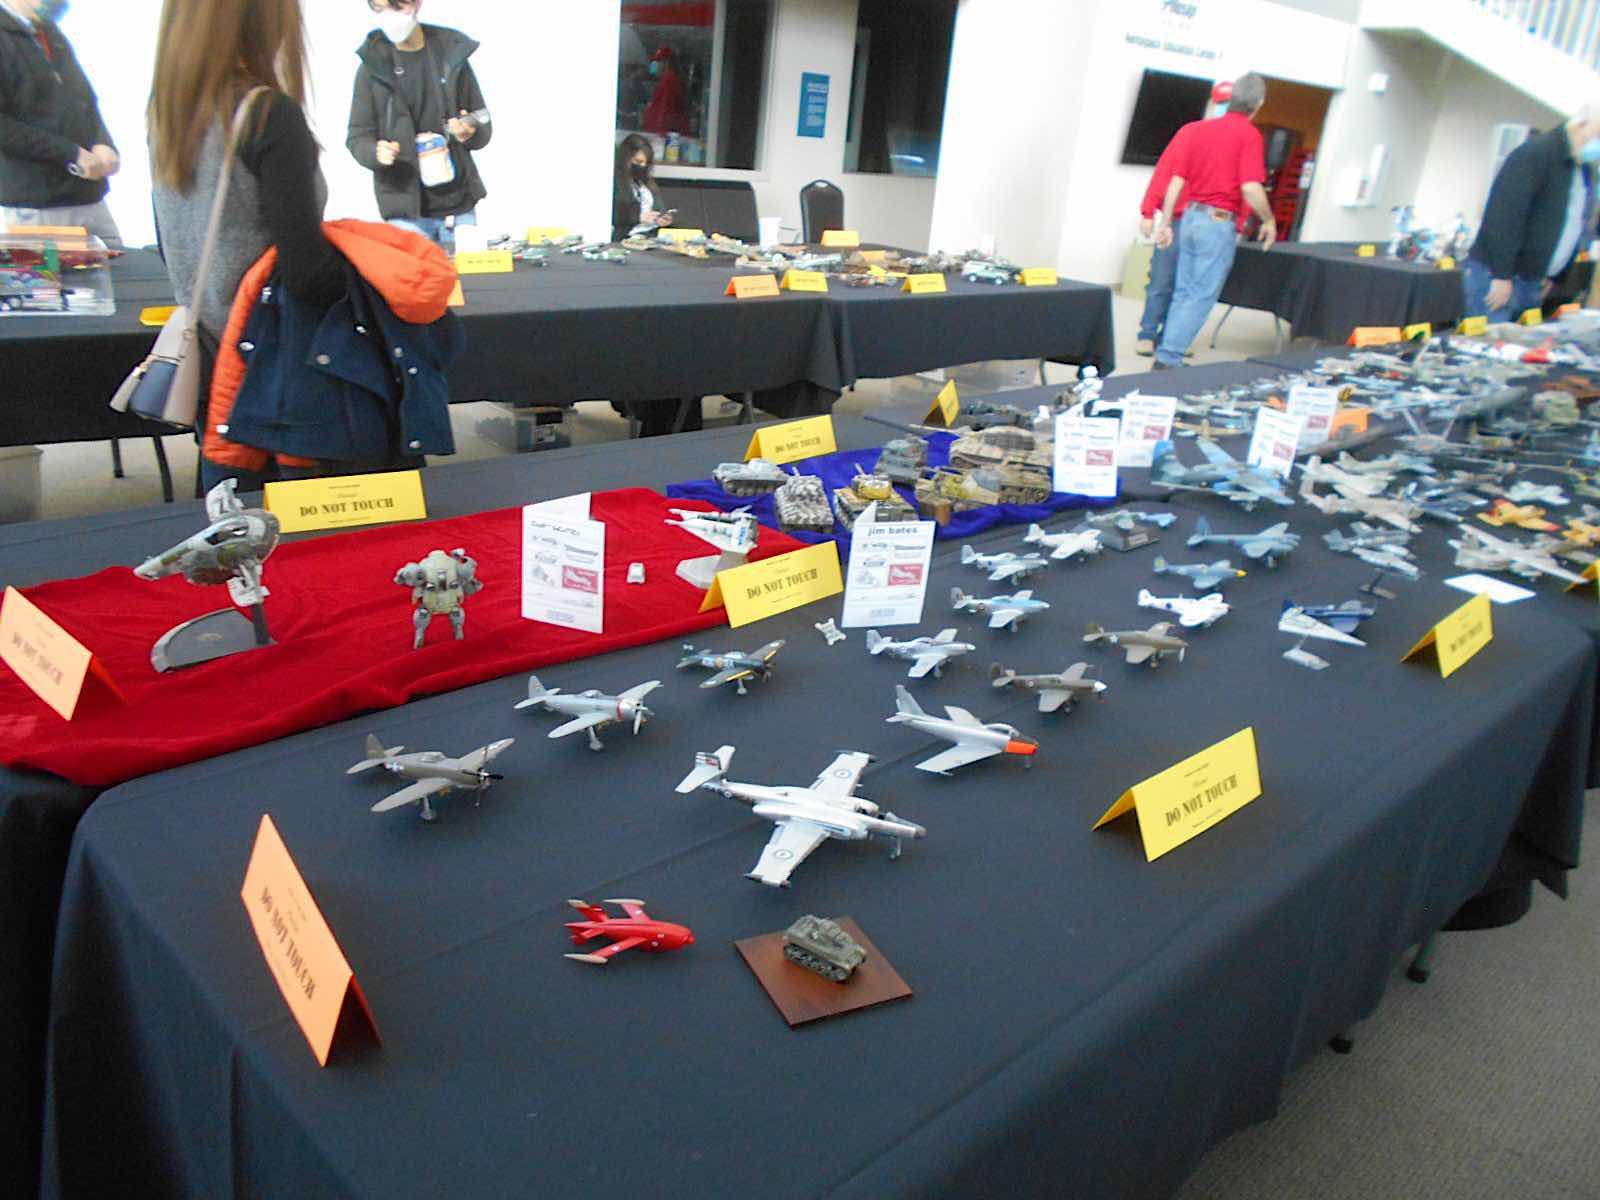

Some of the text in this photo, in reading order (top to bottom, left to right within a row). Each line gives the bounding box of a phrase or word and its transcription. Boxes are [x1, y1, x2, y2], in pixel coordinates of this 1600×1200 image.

[299, 497, 394, 517] DO NOT TOUCH
[868, 527, 885, 537] jim
[746, 587, 762, 599] DO
[763, 579, 784, 593] NOT
[785, 568, 819, 587] TOUCH
[1164, 807, 1182, 827] DO
[1181, 793, 1204, 815] NOT
[1204, 774, 1239, 804] TOUCH
[270, 908, 289, 944] NOT
[285, 937, 317, 1001] TOUCH
